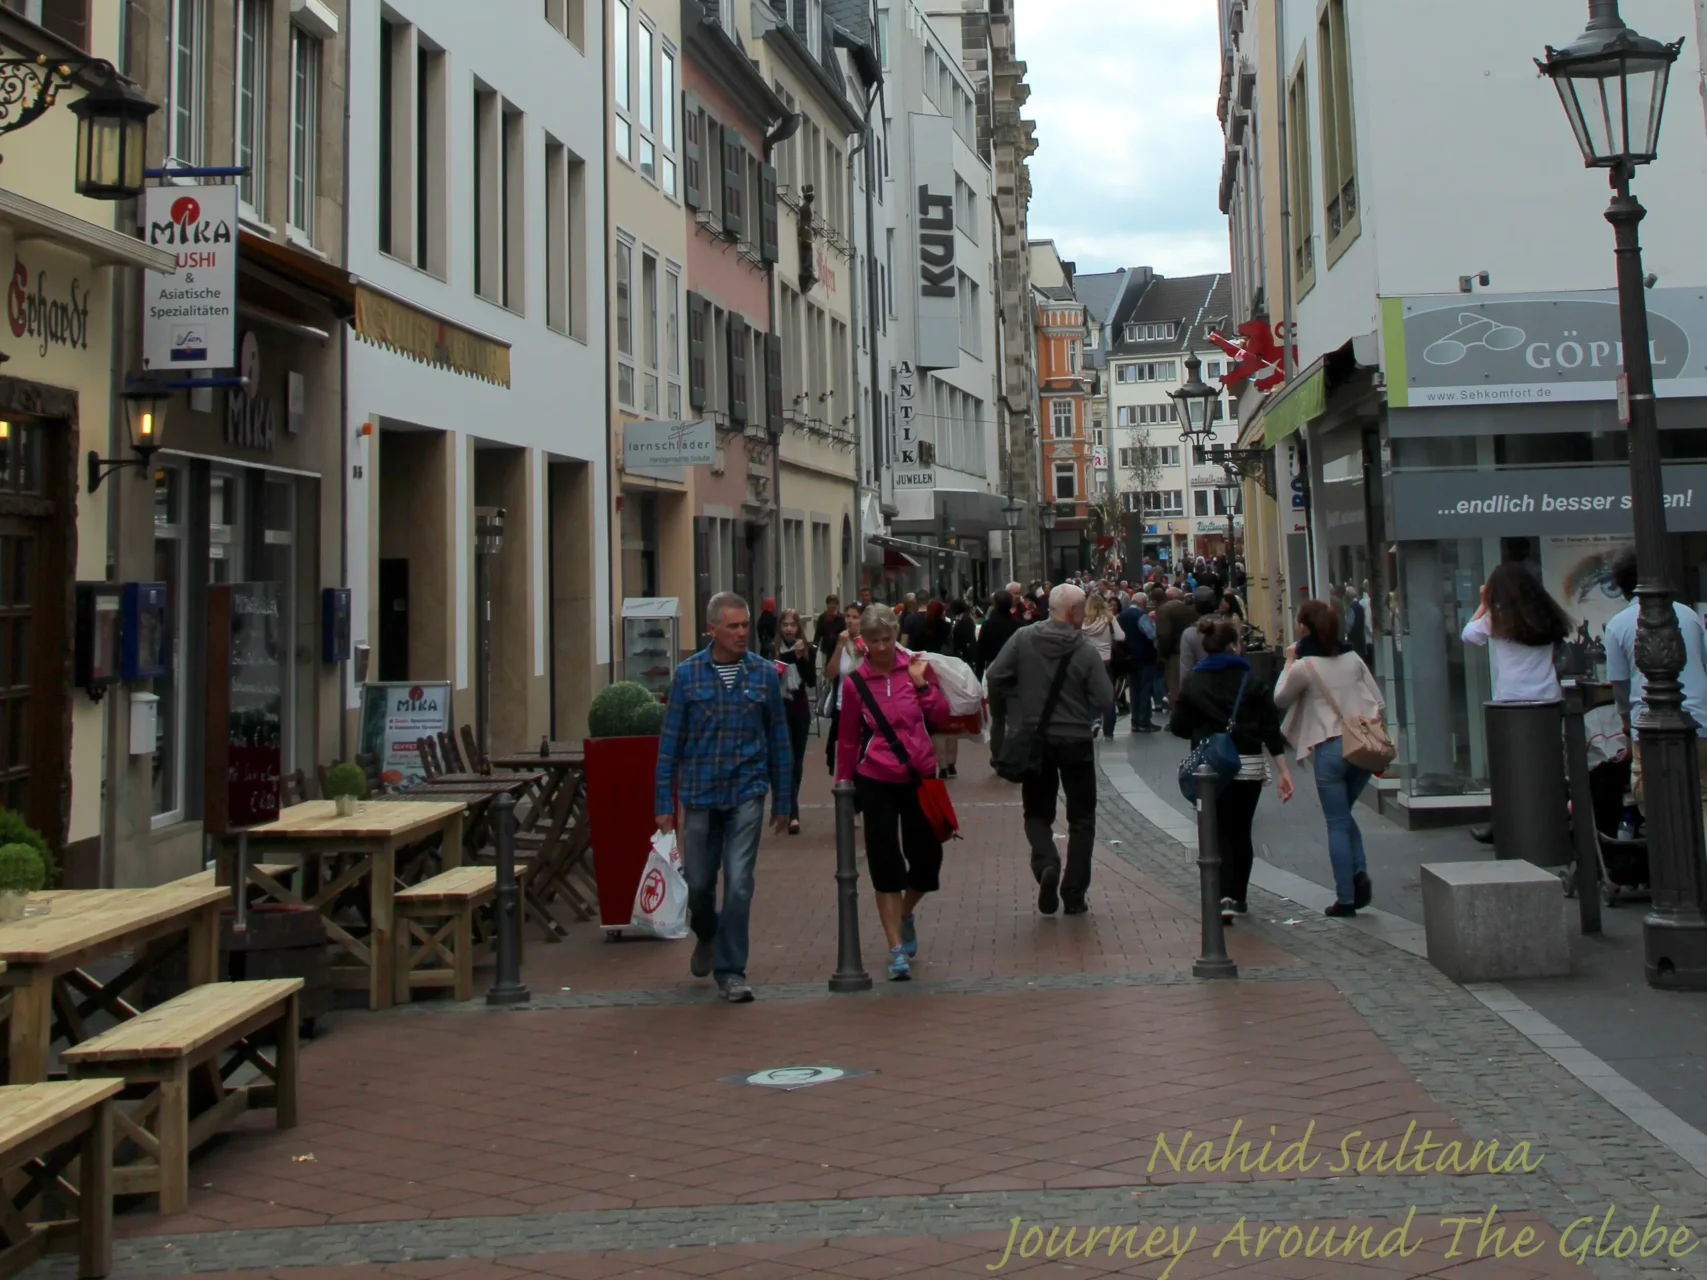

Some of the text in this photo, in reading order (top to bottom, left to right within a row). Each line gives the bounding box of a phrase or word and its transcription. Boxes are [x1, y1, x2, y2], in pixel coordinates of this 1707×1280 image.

[918, 184, 956, 298] KULT
[175, 252, 216, 268] USHI
[185, 273, 194, 283] &
[159, 287, 221, 300] Asiatische
[150, 305, 229, 319] Spezialitäten
[1525, 330, 1666, 368] GÖPL
[1427, 387, 1552, 401] www.Sehkomfort.de
[899, 361, 914, 463] ANTIK
[896, 473, 933, 485] JUWELEN
[1437, 489, 1693, 514] ...endlich besser sen!
